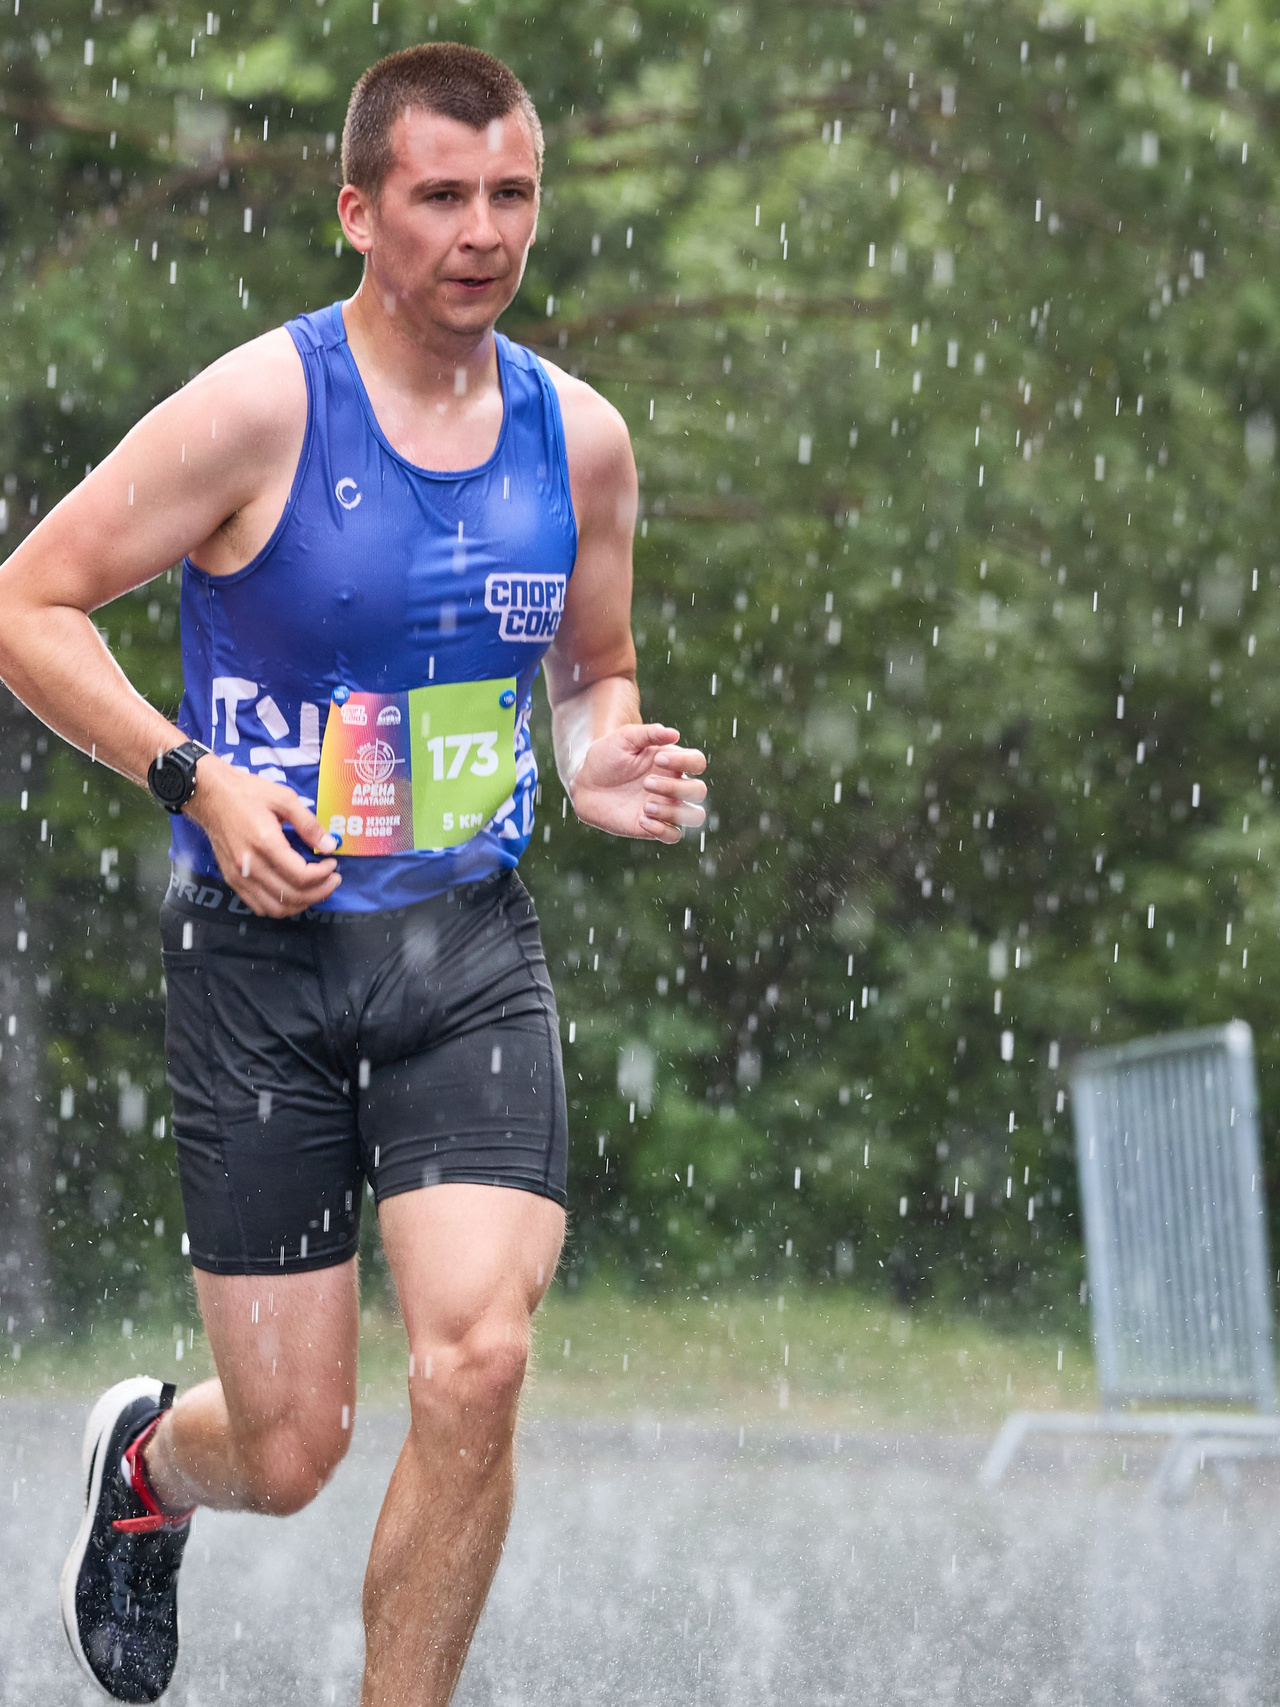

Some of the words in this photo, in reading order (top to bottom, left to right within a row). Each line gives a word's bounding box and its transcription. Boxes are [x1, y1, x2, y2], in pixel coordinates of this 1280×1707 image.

[491, 580, 565, 609] СПОРТ
[505, 609, 562, 637] СОЮ
[427, 731, 499, 781] 173
[352, 783, 395, 796] АРЕНА
[329, 814, 363, 836] 28
[442, 812, 454, 831] 5
[459, 812, 483, 829] КМ
